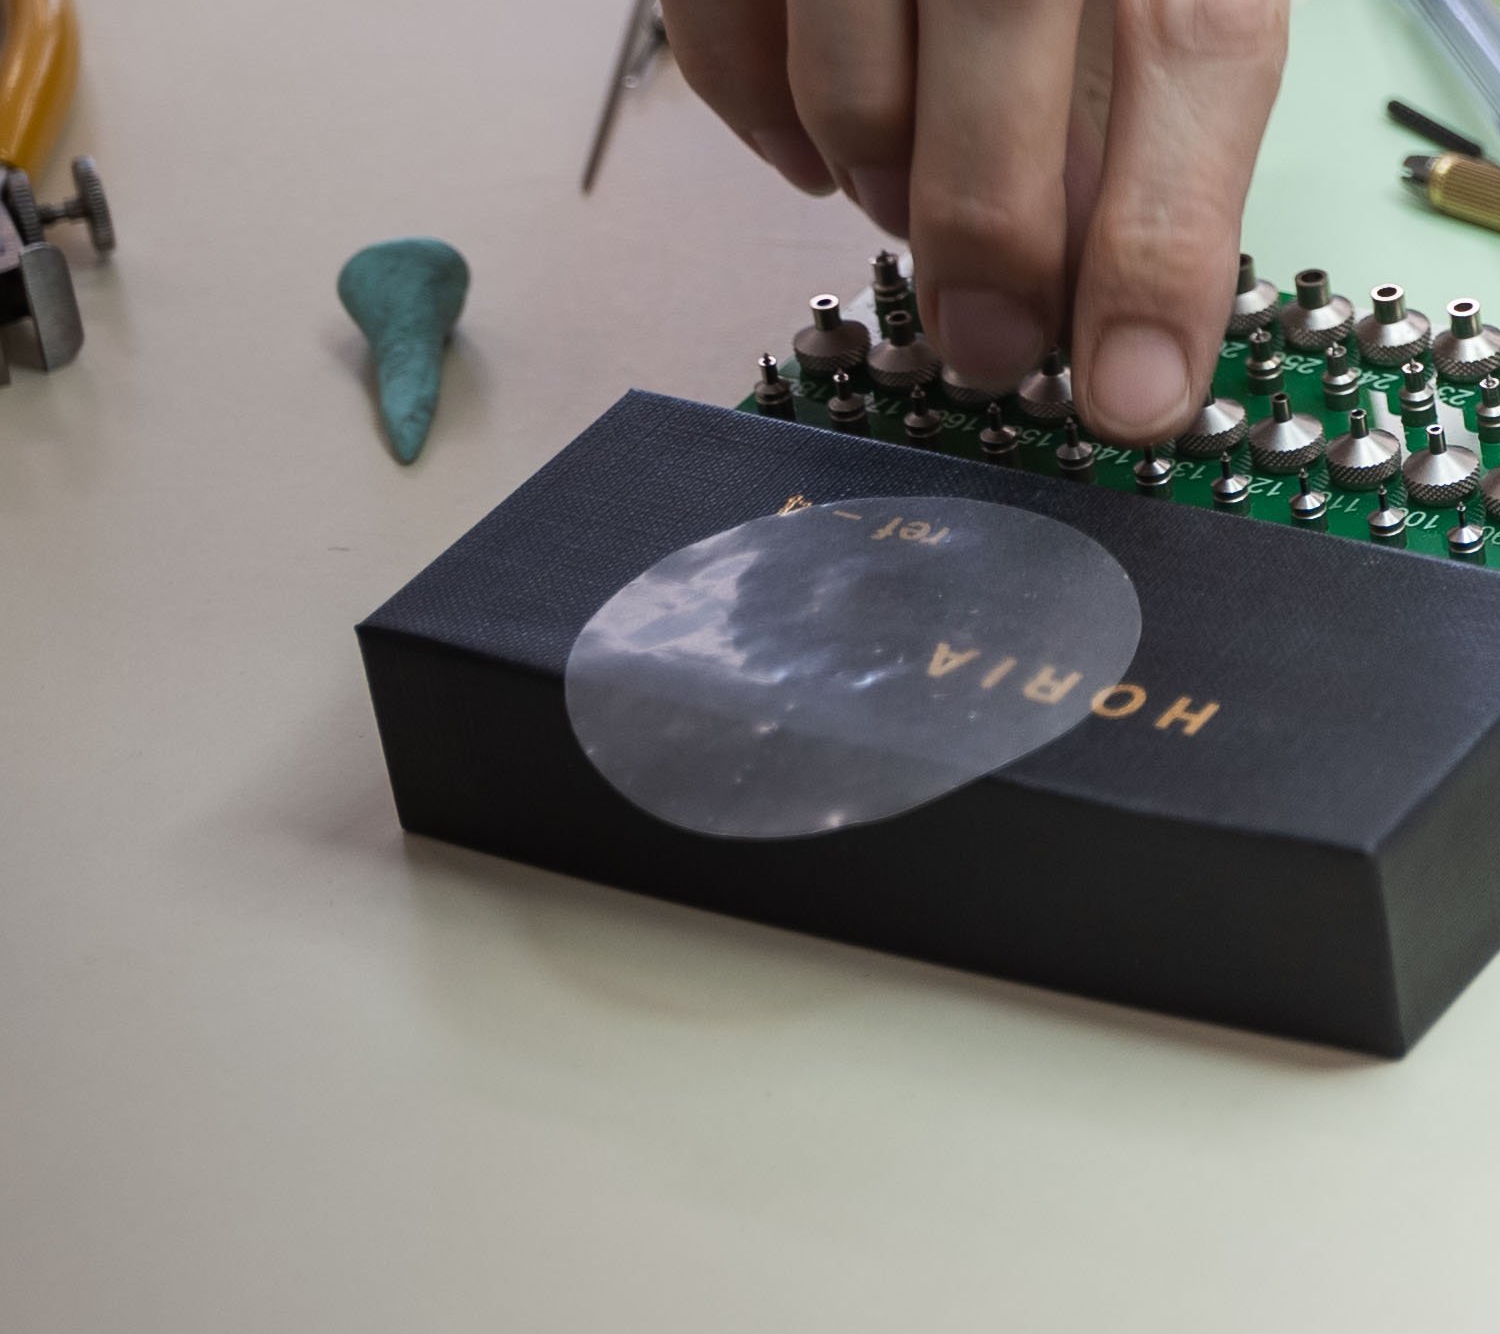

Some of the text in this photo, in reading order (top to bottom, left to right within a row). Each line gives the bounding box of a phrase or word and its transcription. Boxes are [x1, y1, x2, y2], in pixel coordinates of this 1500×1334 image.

[1438, 386, 1475, 406] 23
[1012, 427, 1054, 447] 15
[1239, 474, 1284, 497] 12
[870, 517, 951, 545] ref
[927, 642, 1219, 736] HORIA
